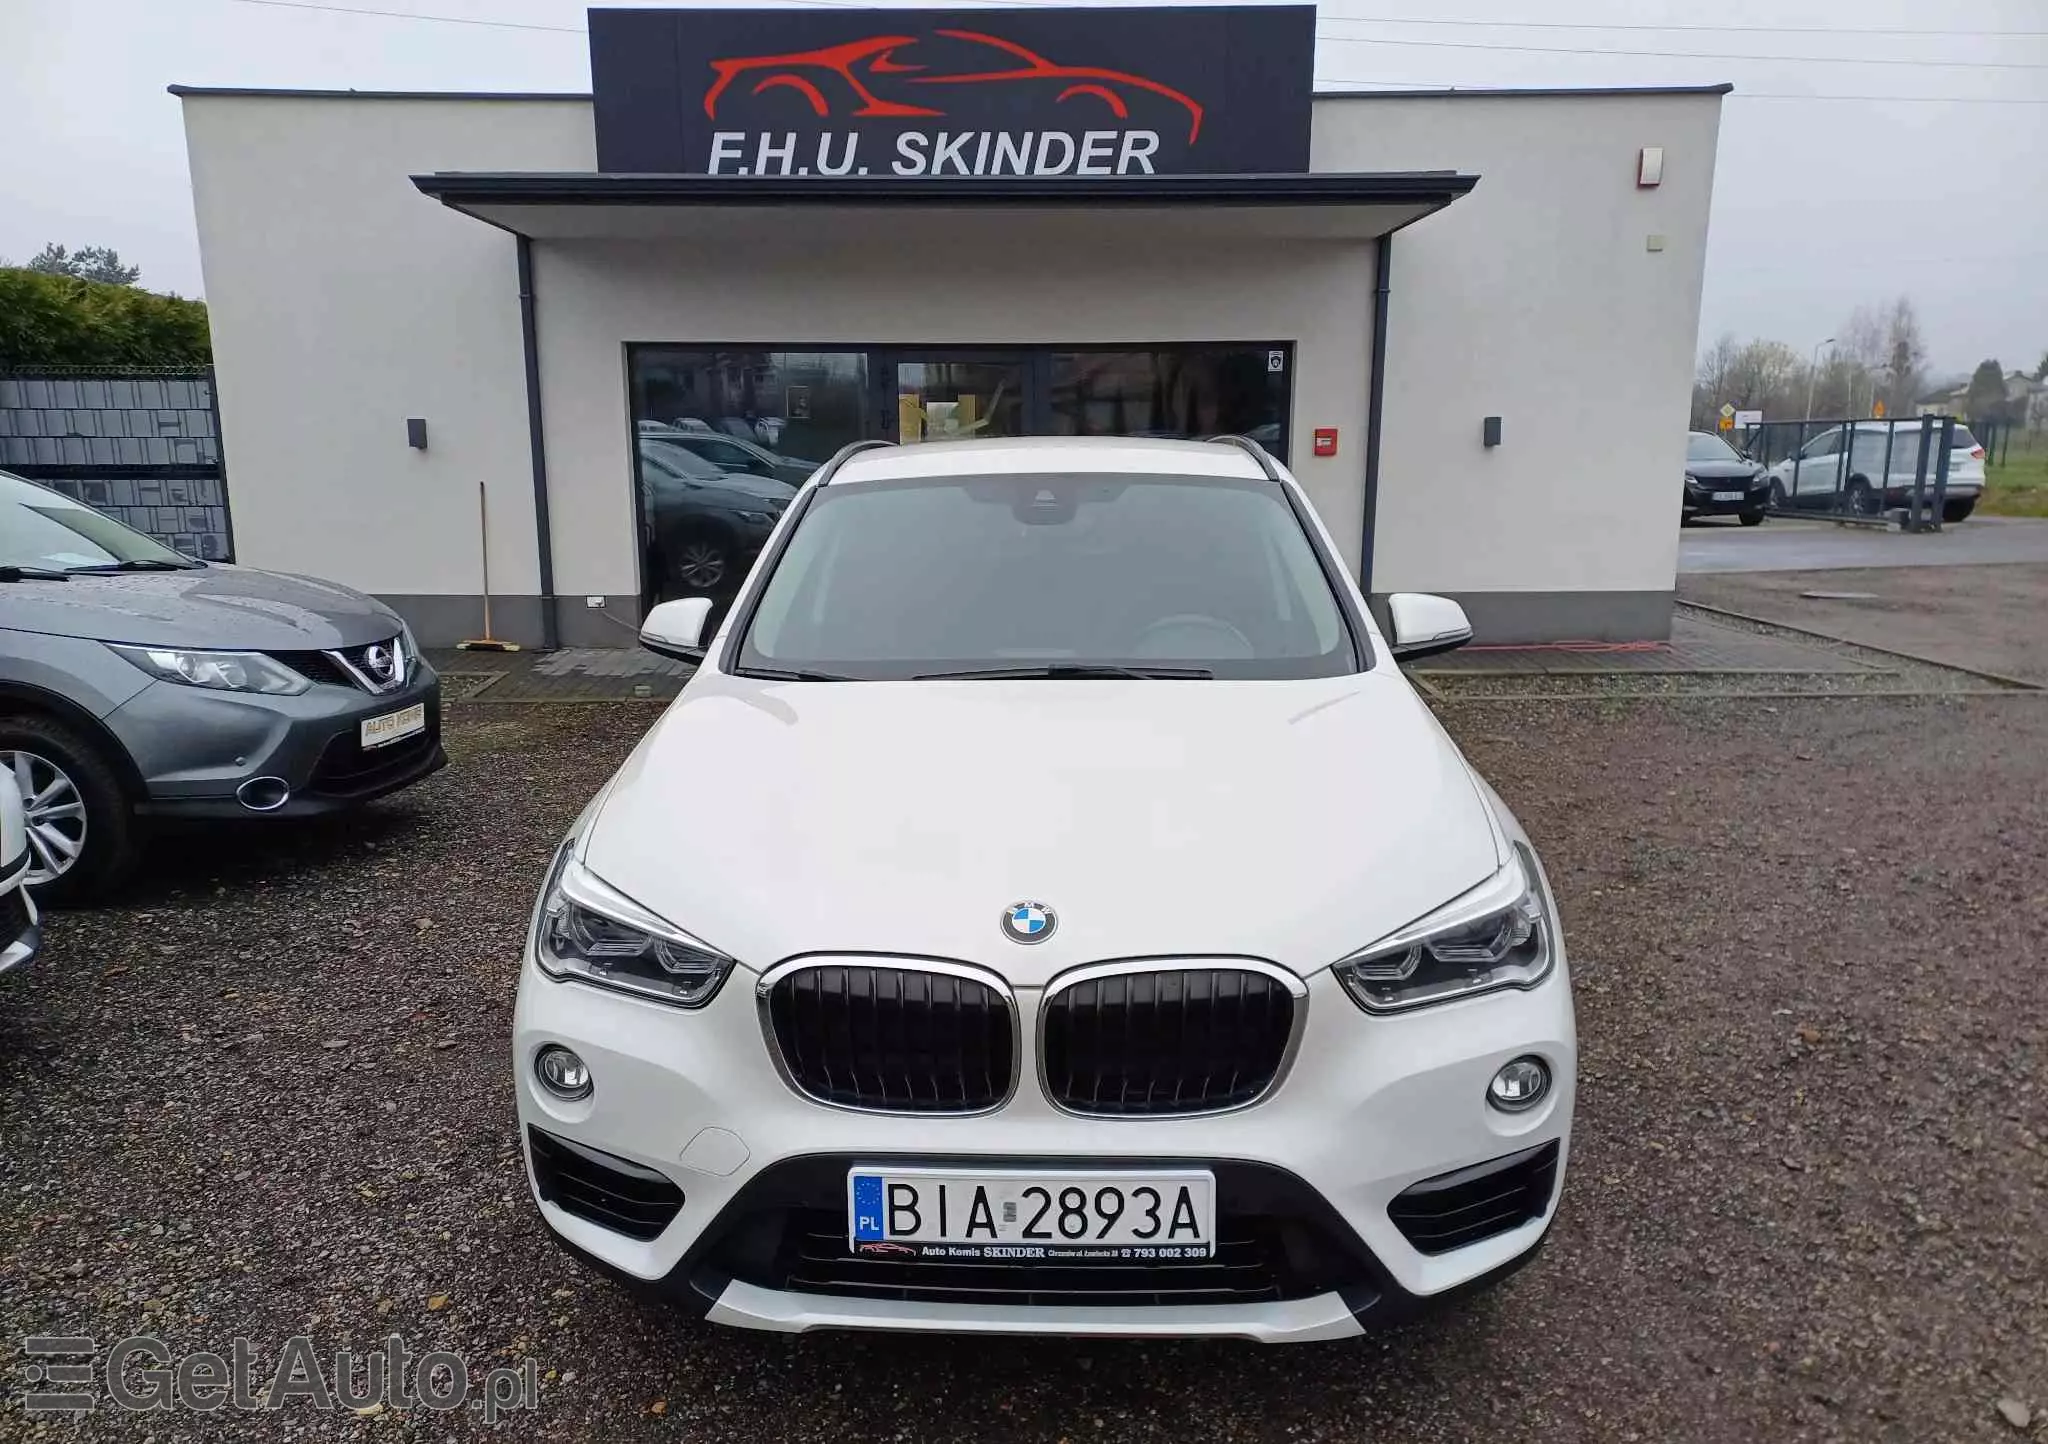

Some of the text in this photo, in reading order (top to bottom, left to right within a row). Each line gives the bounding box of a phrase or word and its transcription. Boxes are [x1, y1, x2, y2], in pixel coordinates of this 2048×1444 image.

[707, 129, 1161, 175] F.H.U. SKINDER
[859, 1215, 881, 1231] PL
[888, 1182, 1201, 1240] BIA 2893A
[922, 1246, 946, 1256] Auto
[948, 1247, 981, 1257] Komis
[983, 1246, 1046, 1258] SKINDER
[1133, 1248, 1156, 1258] 793
[1158, 1248, 1182, 1258] 002
[1184, 1248, 1207, 1258] 309
